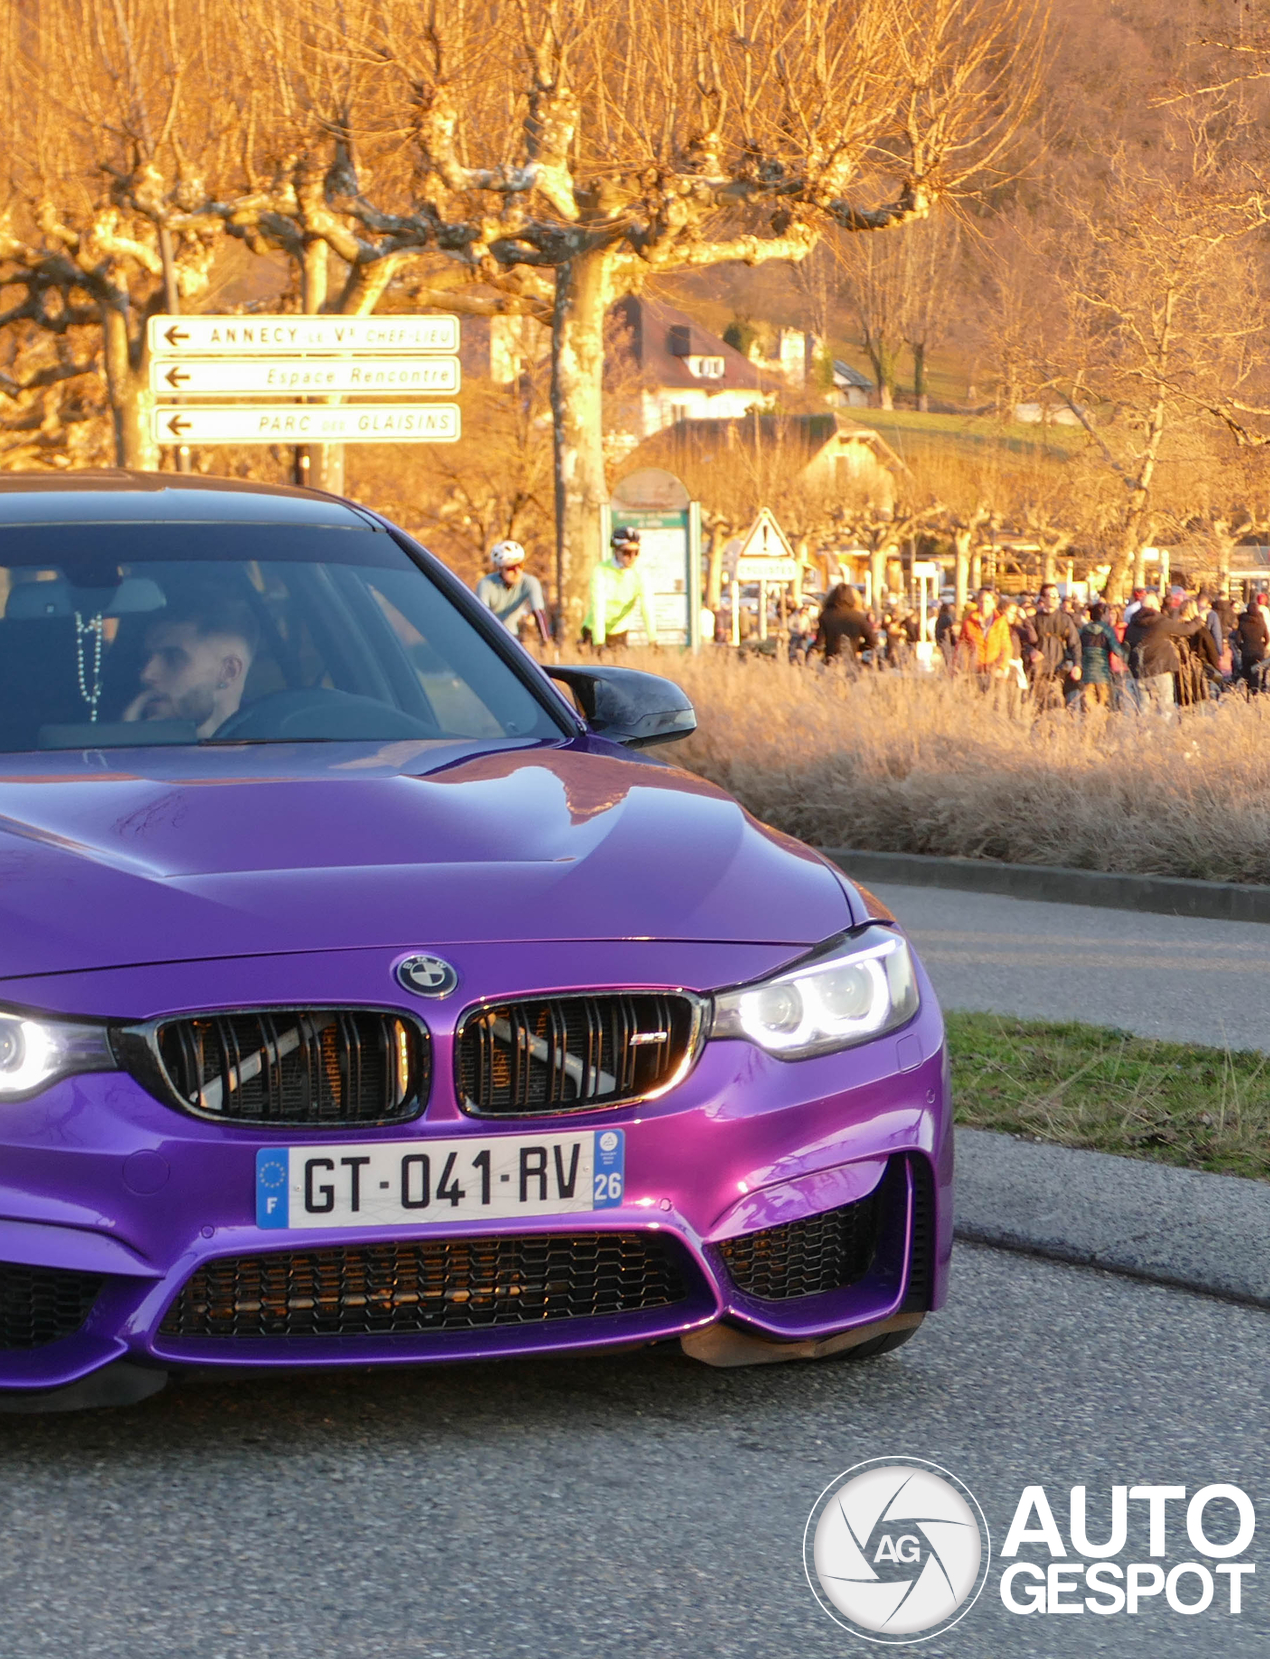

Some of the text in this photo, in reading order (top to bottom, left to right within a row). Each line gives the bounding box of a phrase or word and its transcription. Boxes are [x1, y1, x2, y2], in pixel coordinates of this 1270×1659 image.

[267, 367, 450, 386] Espace Rencontre
[259, 415, 311, 432] PARC
[358, 414, 451, 431] GLAISINS
[304, 1143, 581, 1214] GT-041-RV
[594, 1172, 622, 1201] 26
[266, 1197, 278, 1215] F
